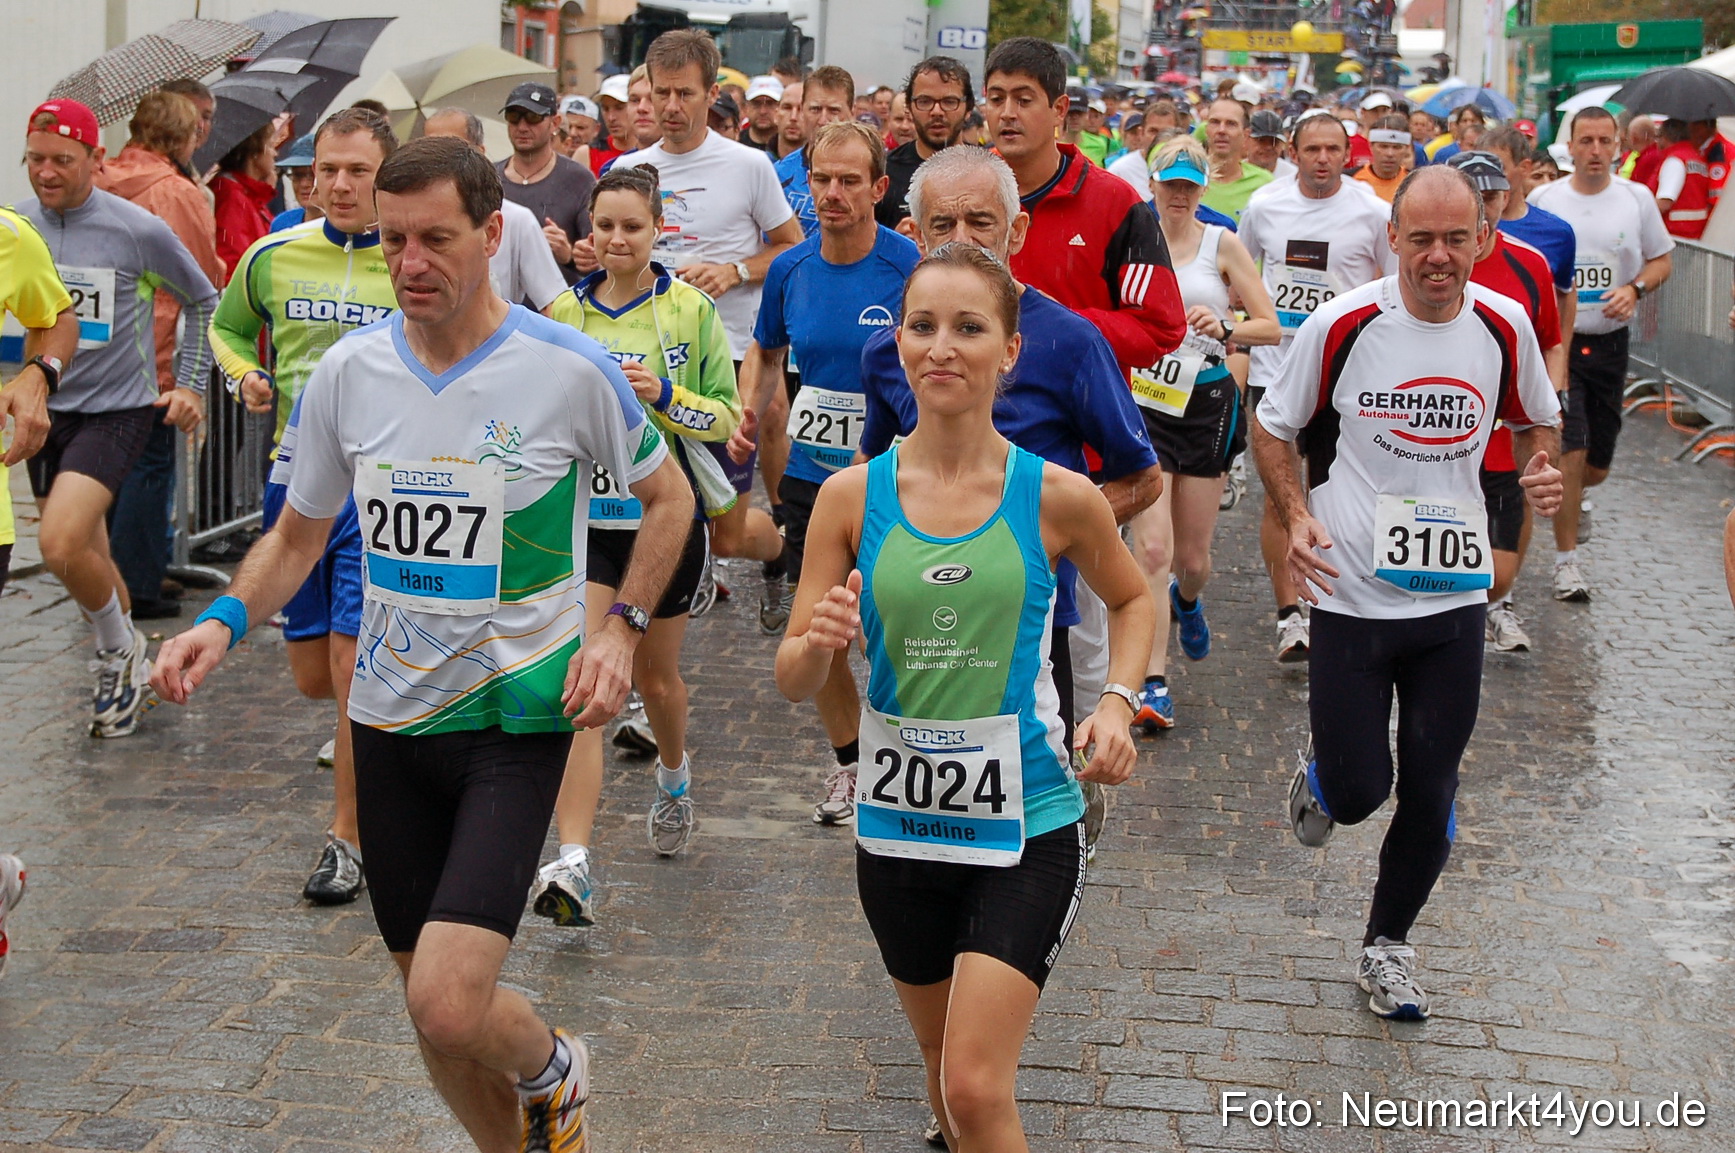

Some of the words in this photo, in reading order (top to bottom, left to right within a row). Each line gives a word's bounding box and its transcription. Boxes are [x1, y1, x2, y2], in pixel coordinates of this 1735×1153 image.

[1575, 268, 1612, 288] 099
[290, 280, 358, 299] TEAM
[286, 298, 393, 326] BOCK
[861, 317, 891, 326] MAN
[1136, 357, 1182, 385] 40
[1131, 380, 1166, 400] Gudrun
[817, 395, 854, 408] BOCK
[1358, 391, 1468, 411] GERHART
[1468, 401, 1475, 410] &
[1358, 409, 1410, 420] Autohaus
[1408, 410, 1476, 430] JÄNIG
[815, 450, 851, 466] Armin
[1372, 434, 1393, 452] Das
[1393, 447, 1441, 463] sportliche
[391, 470, 453, 488] BOCK
[601, 502, 624, 517] Ute
[1414, 504, 1457, 518] BOCK
[367, 498, 488, 559] 2027
[1387, 525, 1483, 569] 3105
[399, 567, 444, 593] Hans
[1409, 575, 1456, 591] Oliver
[904, 637, 957, 647] Reisebüro
[905, 648, 920, 657] Die
[922, 647, 979, 657] Urlaubsinsel
[906, 660, 948, 670] Lufthansa
[968, 657, 999, 668] Center
[900, 727, 966, 745] BOCK
[872, 747, 1007, 814] 2024
[860, 792, 868, 803] B
[901, 817, 976, 841] Nadine
